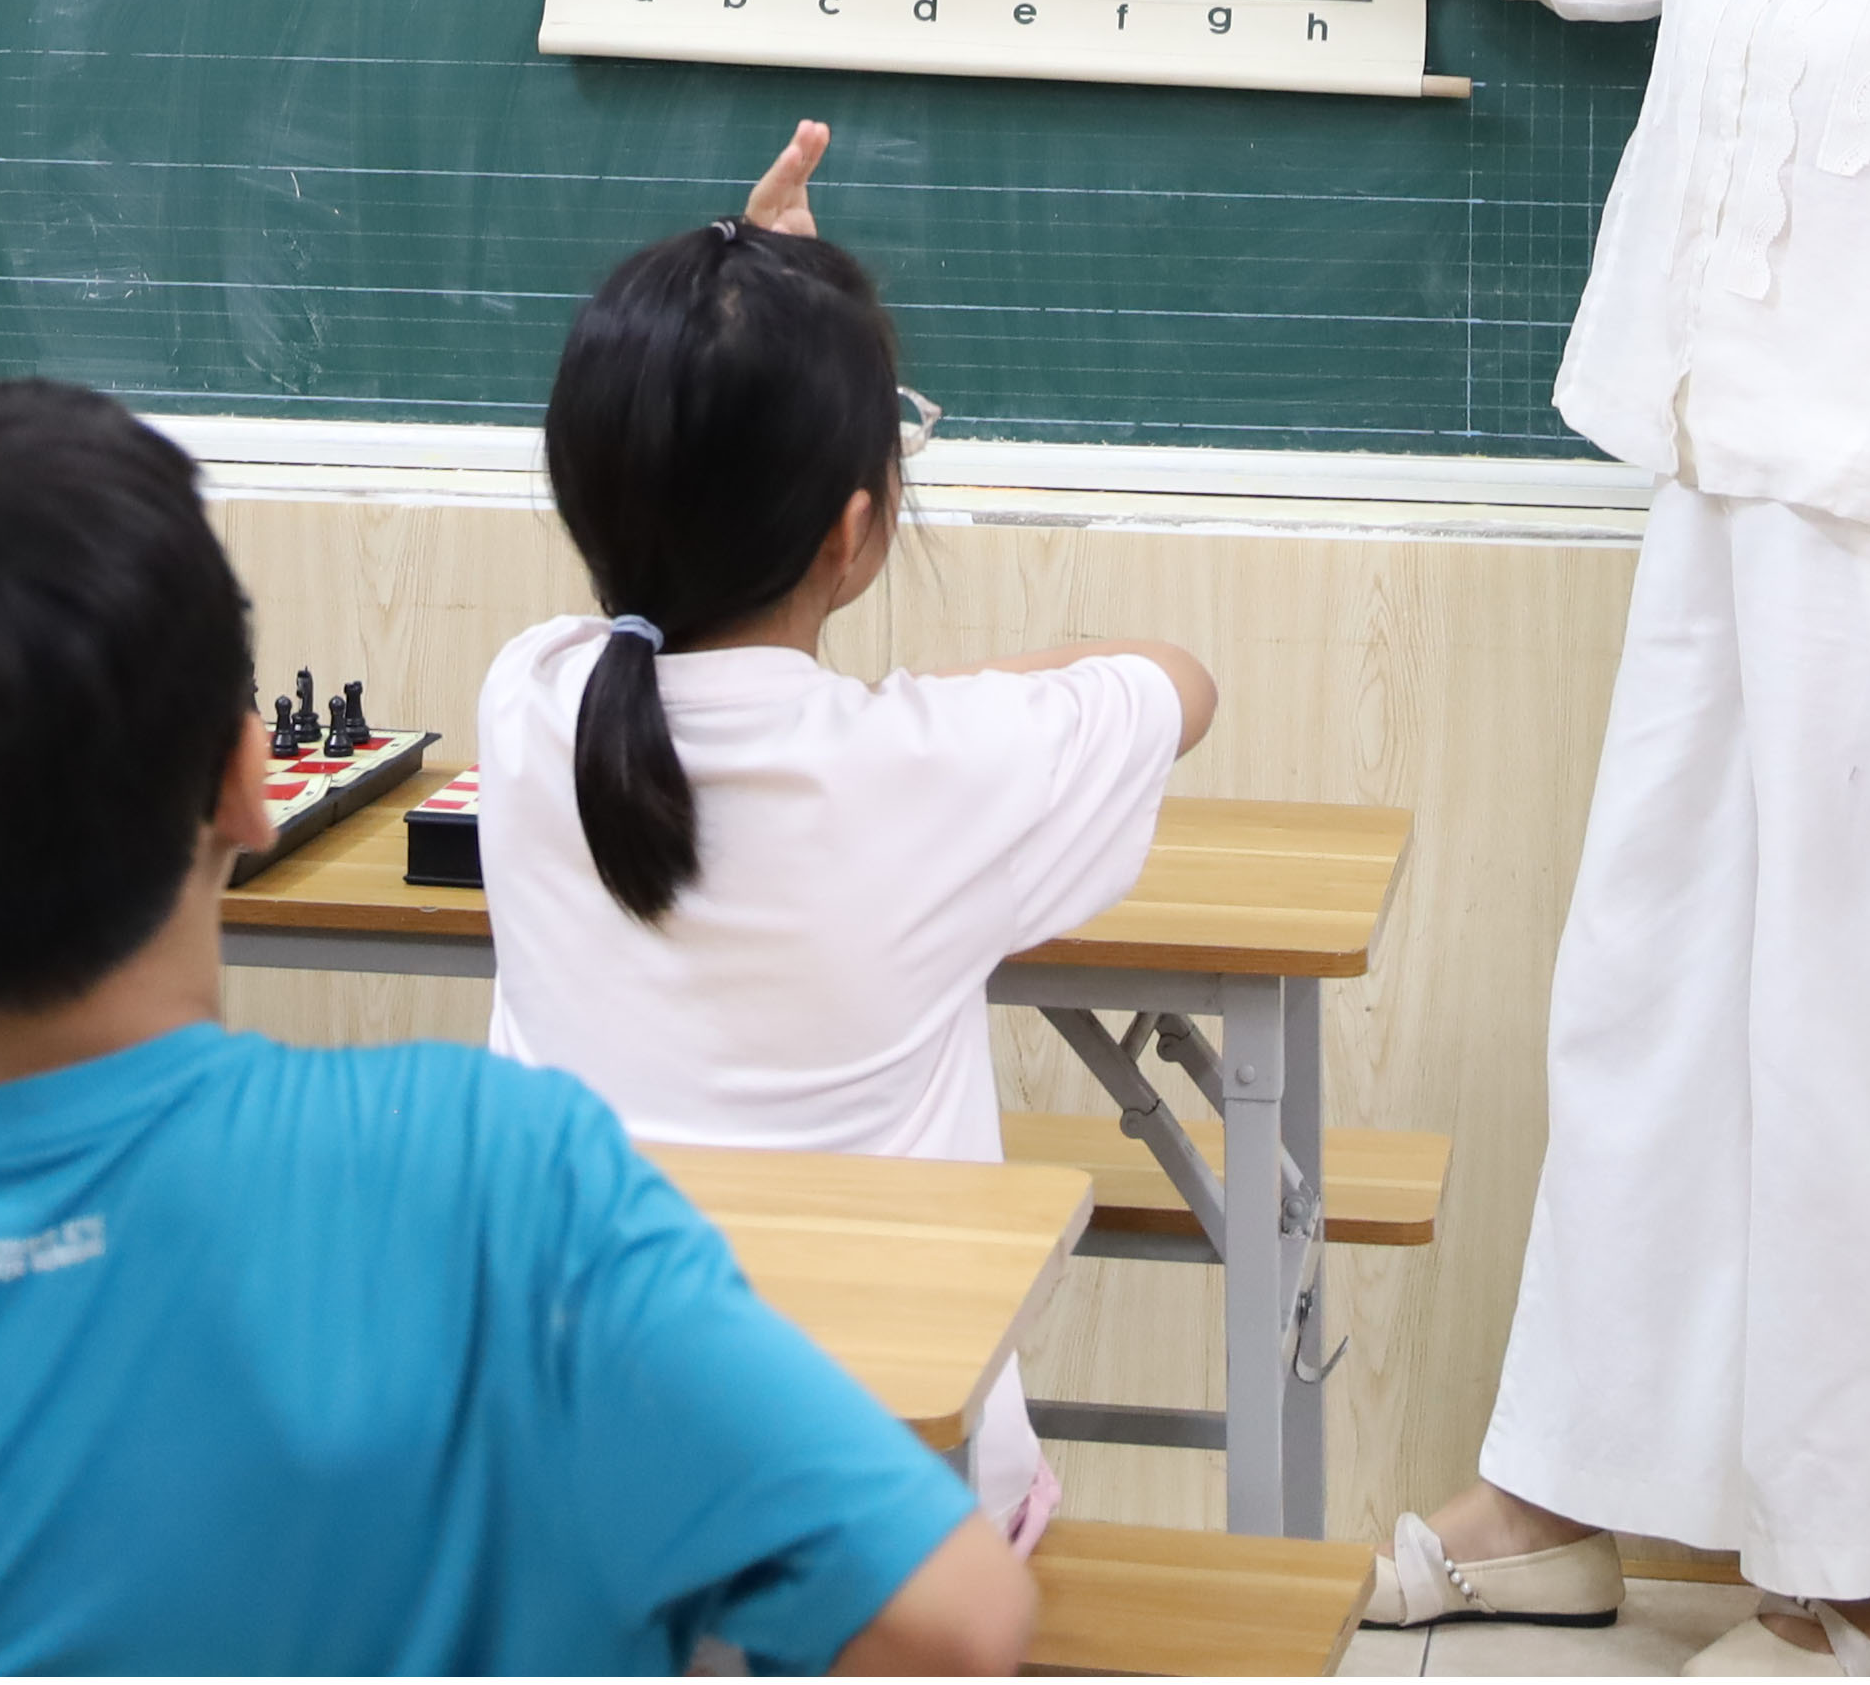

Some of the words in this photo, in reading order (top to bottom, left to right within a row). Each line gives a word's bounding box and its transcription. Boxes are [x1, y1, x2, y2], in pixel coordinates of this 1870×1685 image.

[1012, 2, 1038, 26] e
[1115, 2, 1130, 31] f
[1206, 5, 1233, 36] g
[1306, 11, 1329, 43] h
